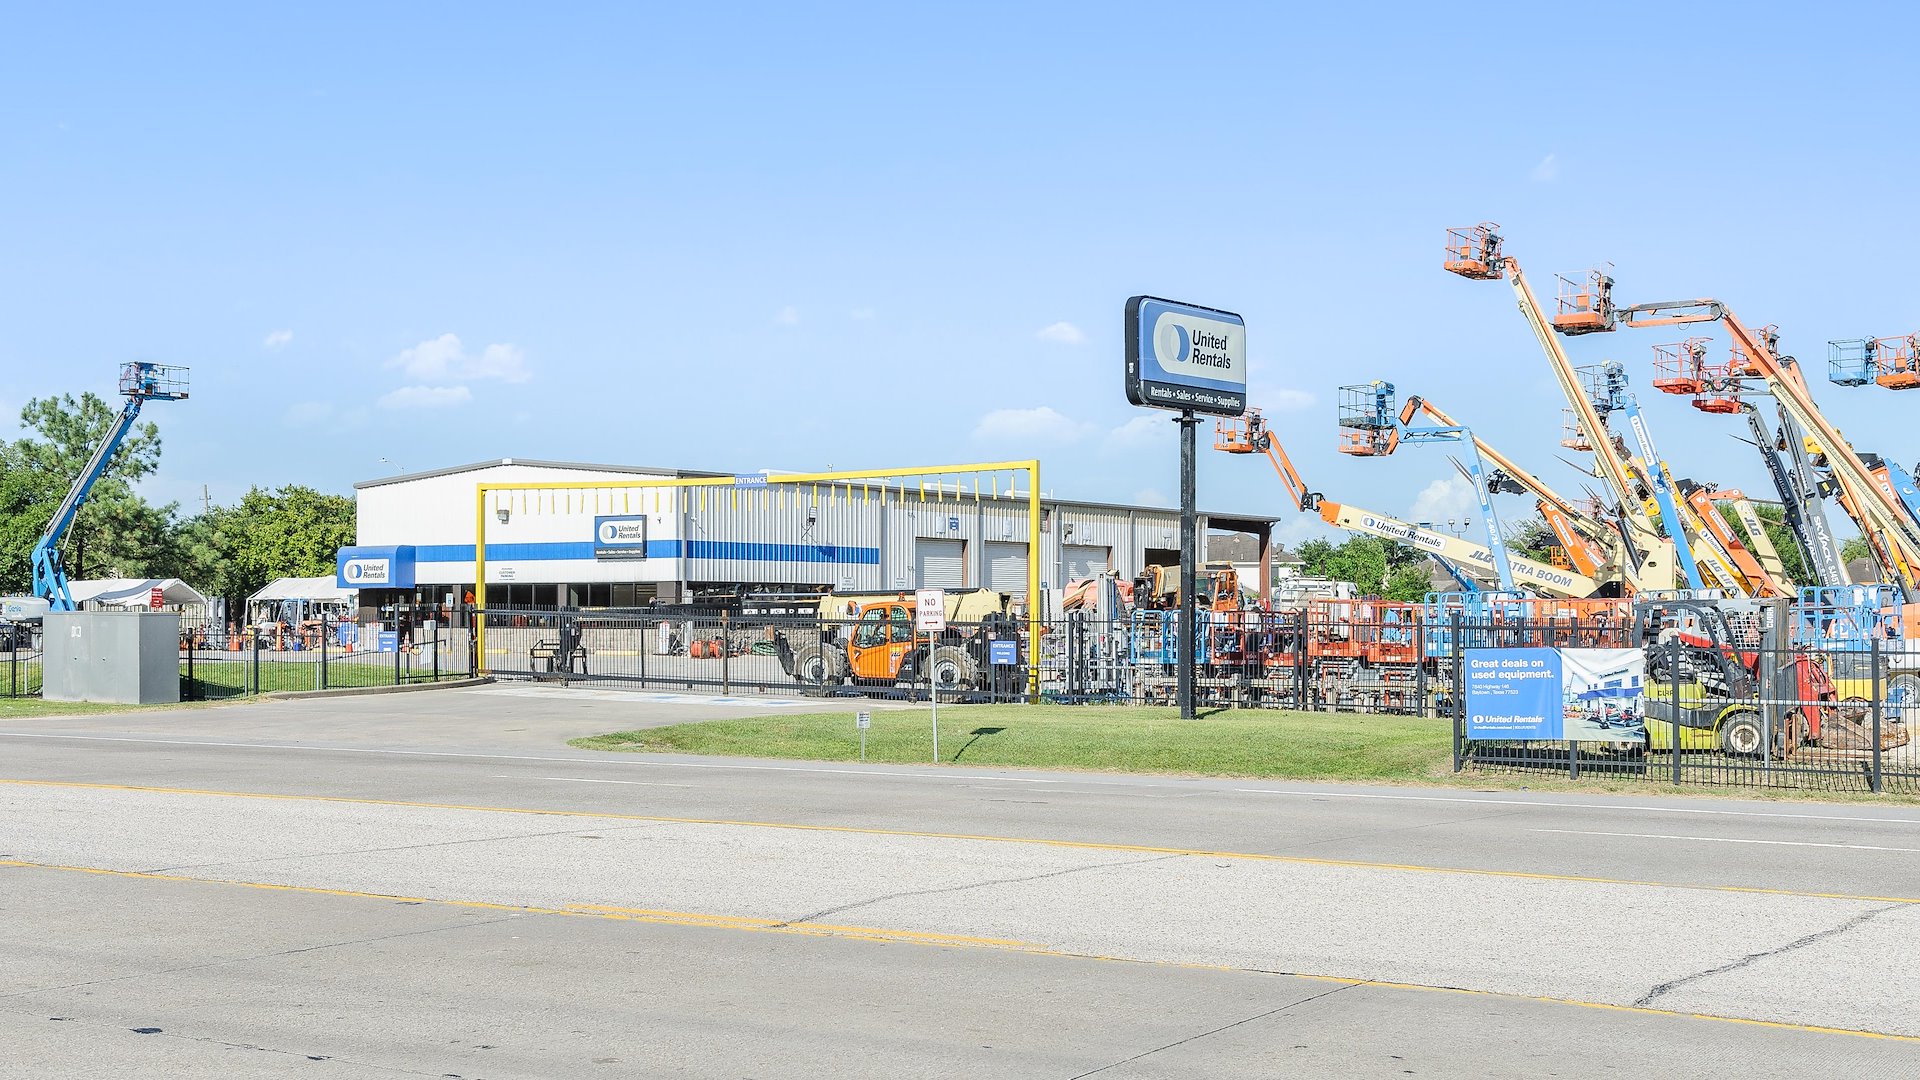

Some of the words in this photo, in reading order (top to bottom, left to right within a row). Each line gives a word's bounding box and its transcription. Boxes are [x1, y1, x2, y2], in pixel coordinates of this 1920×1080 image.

[1192, 329, 1227, 351] United
[1192, 347, 1231, 369] Rentals
[1150, 386, 1172, 399] Rentals
[1176, 389, 1191, 401] Sales
[1195, 393, 1214, 404] Service
[1217, 396, 1240, 409] Supplies
[736, 477, 767, 485] ENTRANCE
[1376, 521, 1408, 537] United
[1407, 531, 1442, 548] Rentals
[1744, 517, 1762, 536] JLG
[1798, 524, 1818, 567] SKYJA
[1814, 516, 1833, 565] SKYJACK
[1469, 551, 1494, 564] JLG
[1510, 561, 1534, 576] TRA
[1536, 570, 1573, 587] BOOM
[1707, 560, 1723, 573] JLG
[924, 598, 936, 606] NO
[1471, 659, 1499, 668] Great
[1501, 659, 1529, 668] deals
[1472, 670, 1496, 679] used
[1498, 670, 1555, 680] equipment.
[1485, 715, 1513, 723] United
